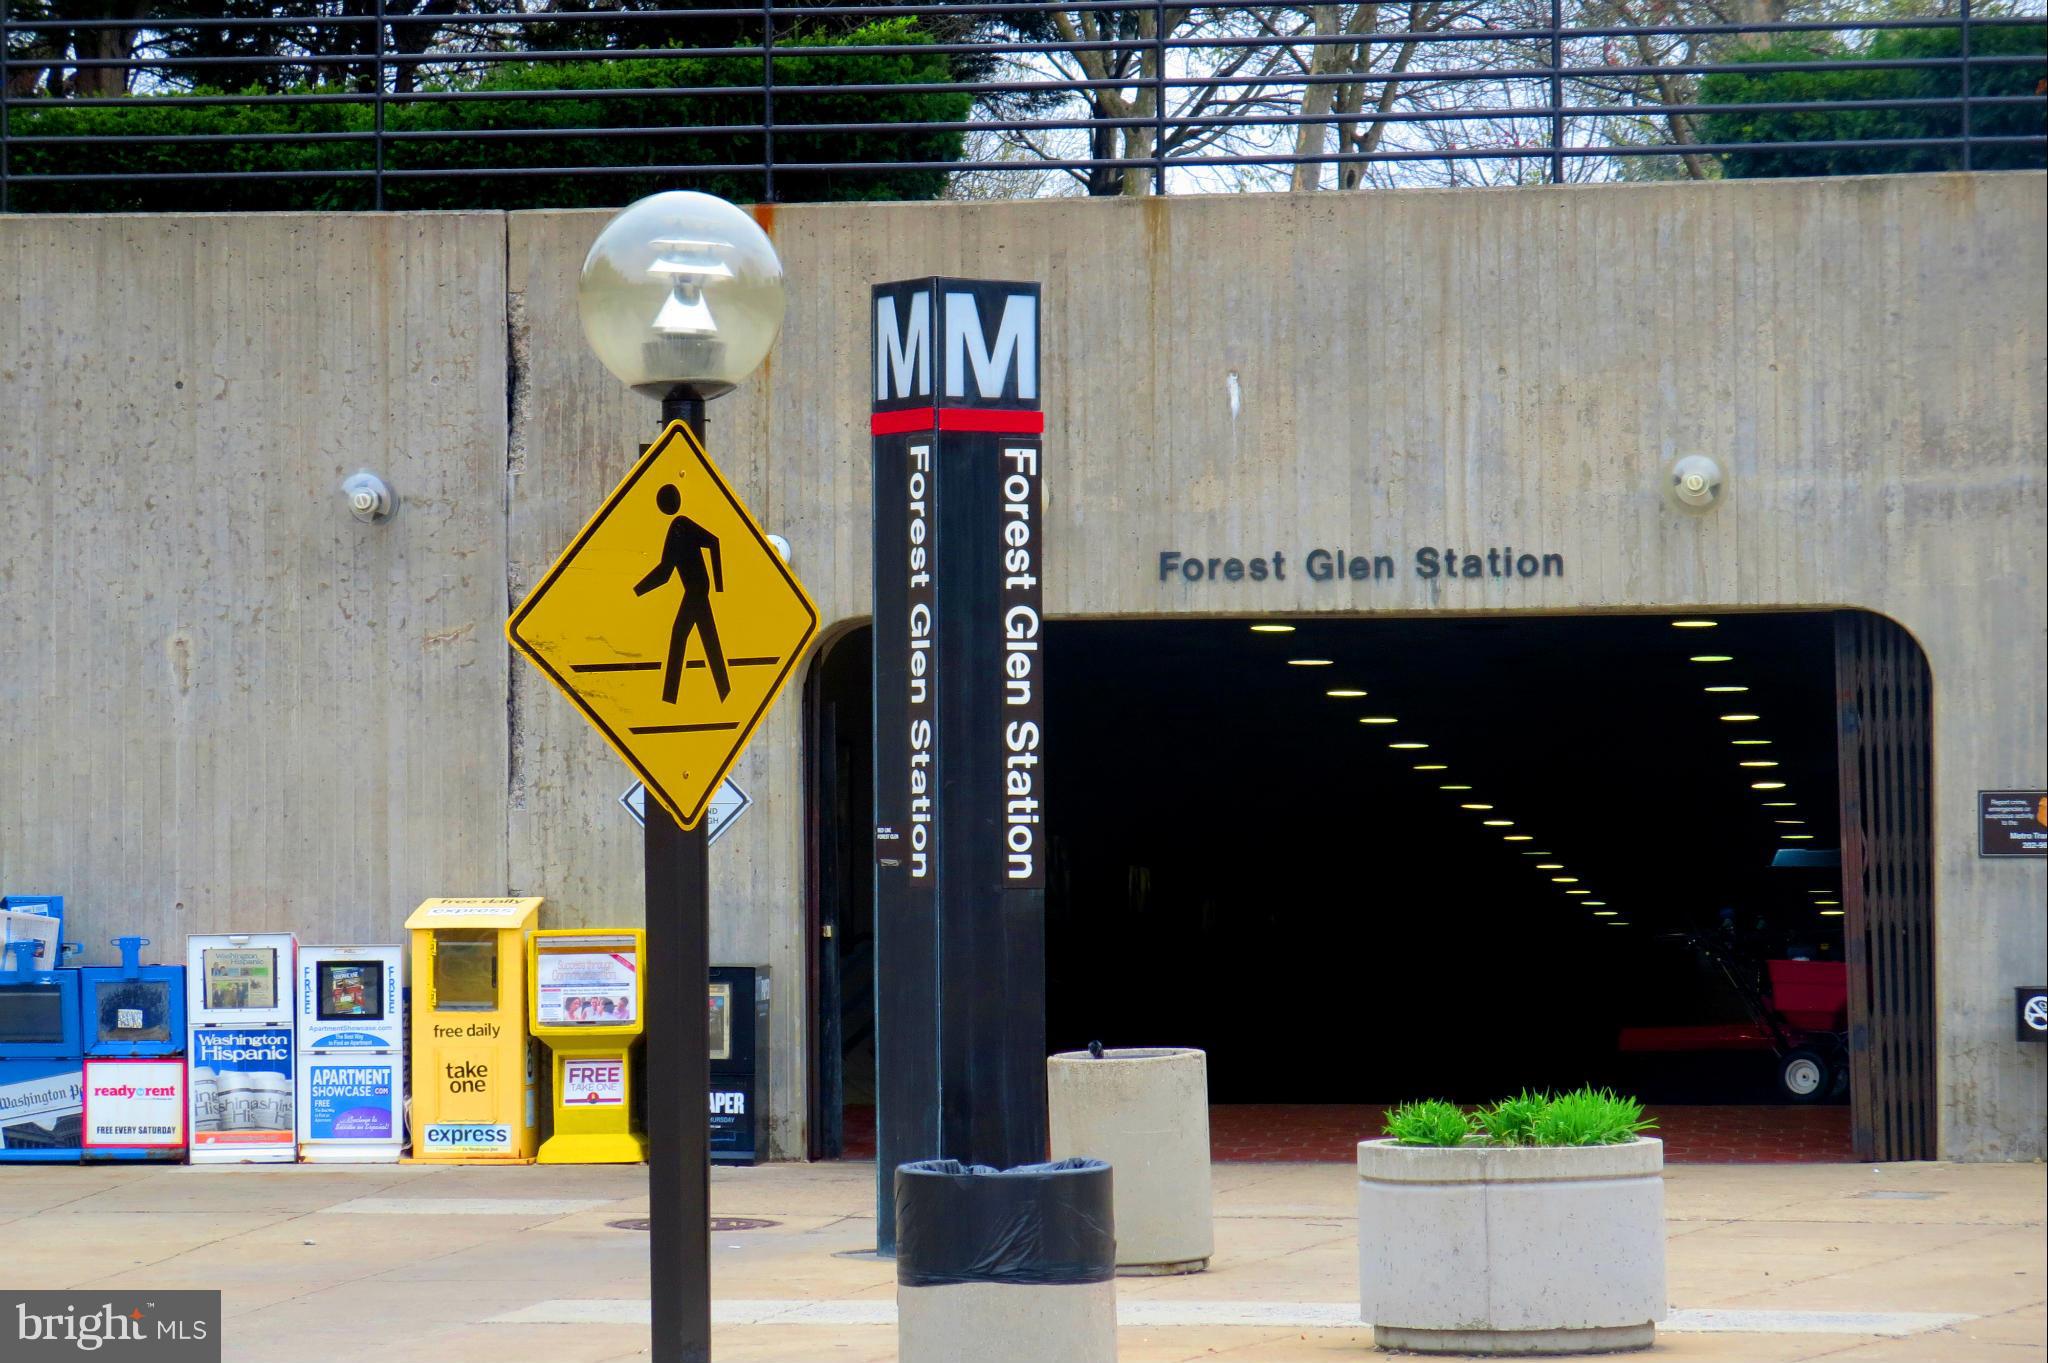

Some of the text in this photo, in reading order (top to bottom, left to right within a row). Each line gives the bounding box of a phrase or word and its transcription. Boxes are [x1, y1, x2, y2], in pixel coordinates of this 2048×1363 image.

[878, 292, 930, 401] M
[945, 292, 1036, 399] M
[1159, 546, 1564, 582] Forest Glen Station
[910, 446, 931, 877] Forest Glen Station
[1004, 447, 1040, 878] Forest Glen Station
[388, 965, 396, 1014] FREE
[433, 1023, 501, 1039] free daily
[198, 1034, 288, 1047] Washington
[201, 1046, 289, 1063] Hispanic
[312, 1068, 391, 1086] APARTMENT
[446, 1061, 488, 1079] take
[569, 1067, 620, 1083] FREE
[449, 1079, 486, 1094] one
[571, 1083, 617, 1092] TAKE ONE
[314, 1099, 331, 1108] FREE
[96, 1125, 177, 1135] FREE EVERY SATURDAY
[427, 1128, 508, 1145] express
